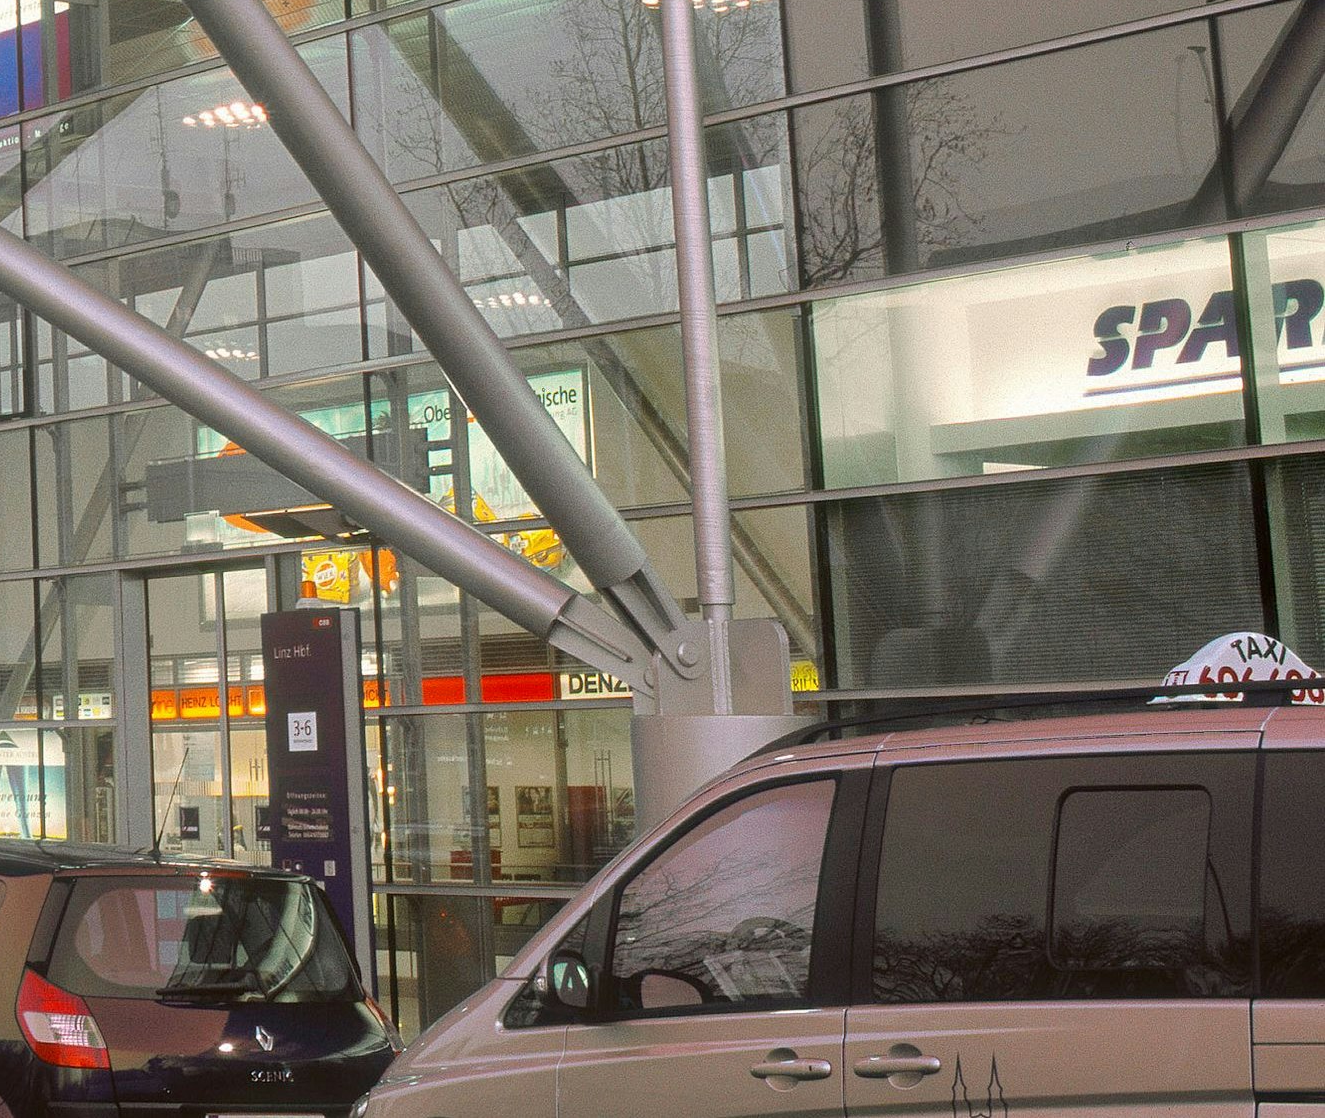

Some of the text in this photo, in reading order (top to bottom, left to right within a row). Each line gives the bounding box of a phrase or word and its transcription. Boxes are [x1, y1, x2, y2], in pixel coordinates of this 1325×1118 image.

[1086, 279, 1325, 376] SPAR
[273, 647, 292, 659] Linz
[1231, 636, 1287, 665] TAXI
[568, 673, 634, 695] DENZ
[182, 696, 207, 709] HEINZ
